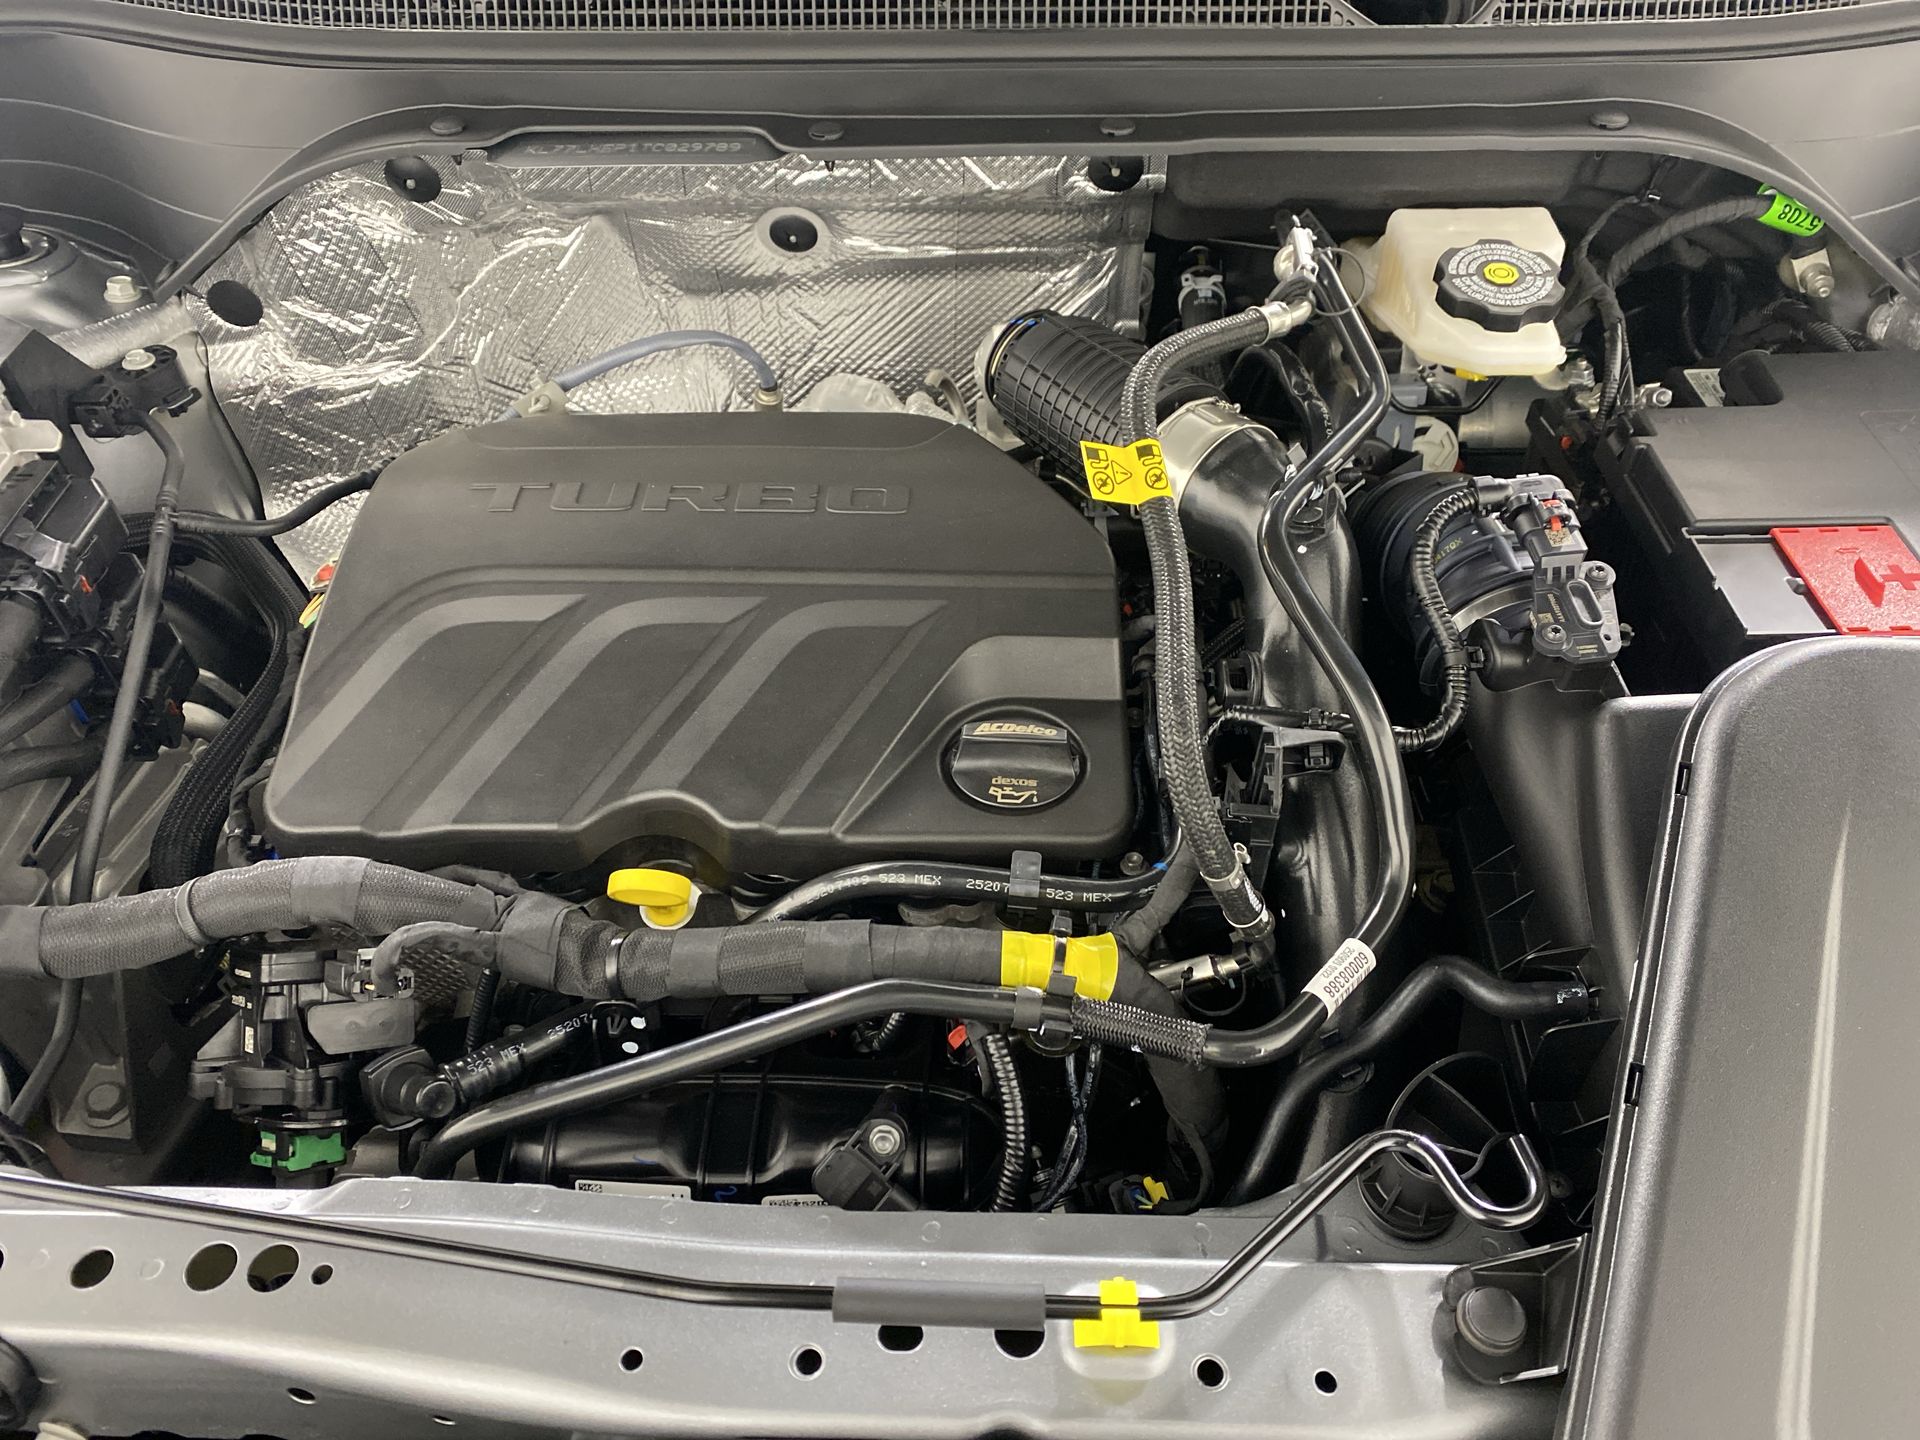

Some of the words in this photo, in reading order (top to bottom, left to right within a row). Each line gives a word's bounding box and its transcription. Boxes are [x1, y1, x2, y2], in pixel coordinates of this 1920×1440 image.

[1777, 203, 1822, 231] 5708
[468, 481, 911, 514] TURBO
[973, 722, 1058, 736] ACDelco
[991, 775, 1038, 787] dexos
[878, 873, 906, 884] 523
[914, 874, 942, 886] MEX
[965, 878, 1010, 893] 25207
[1045, 887, 1074, 901] 523
[1082, 891, 1112, 903] MEX
[1322, 951, 1370, 998] 60008388
[466, 1056, 495, 1076] 523
[499, 1042, 528, 1063] MEX
[546, 1013, 593, 1040] 25207
